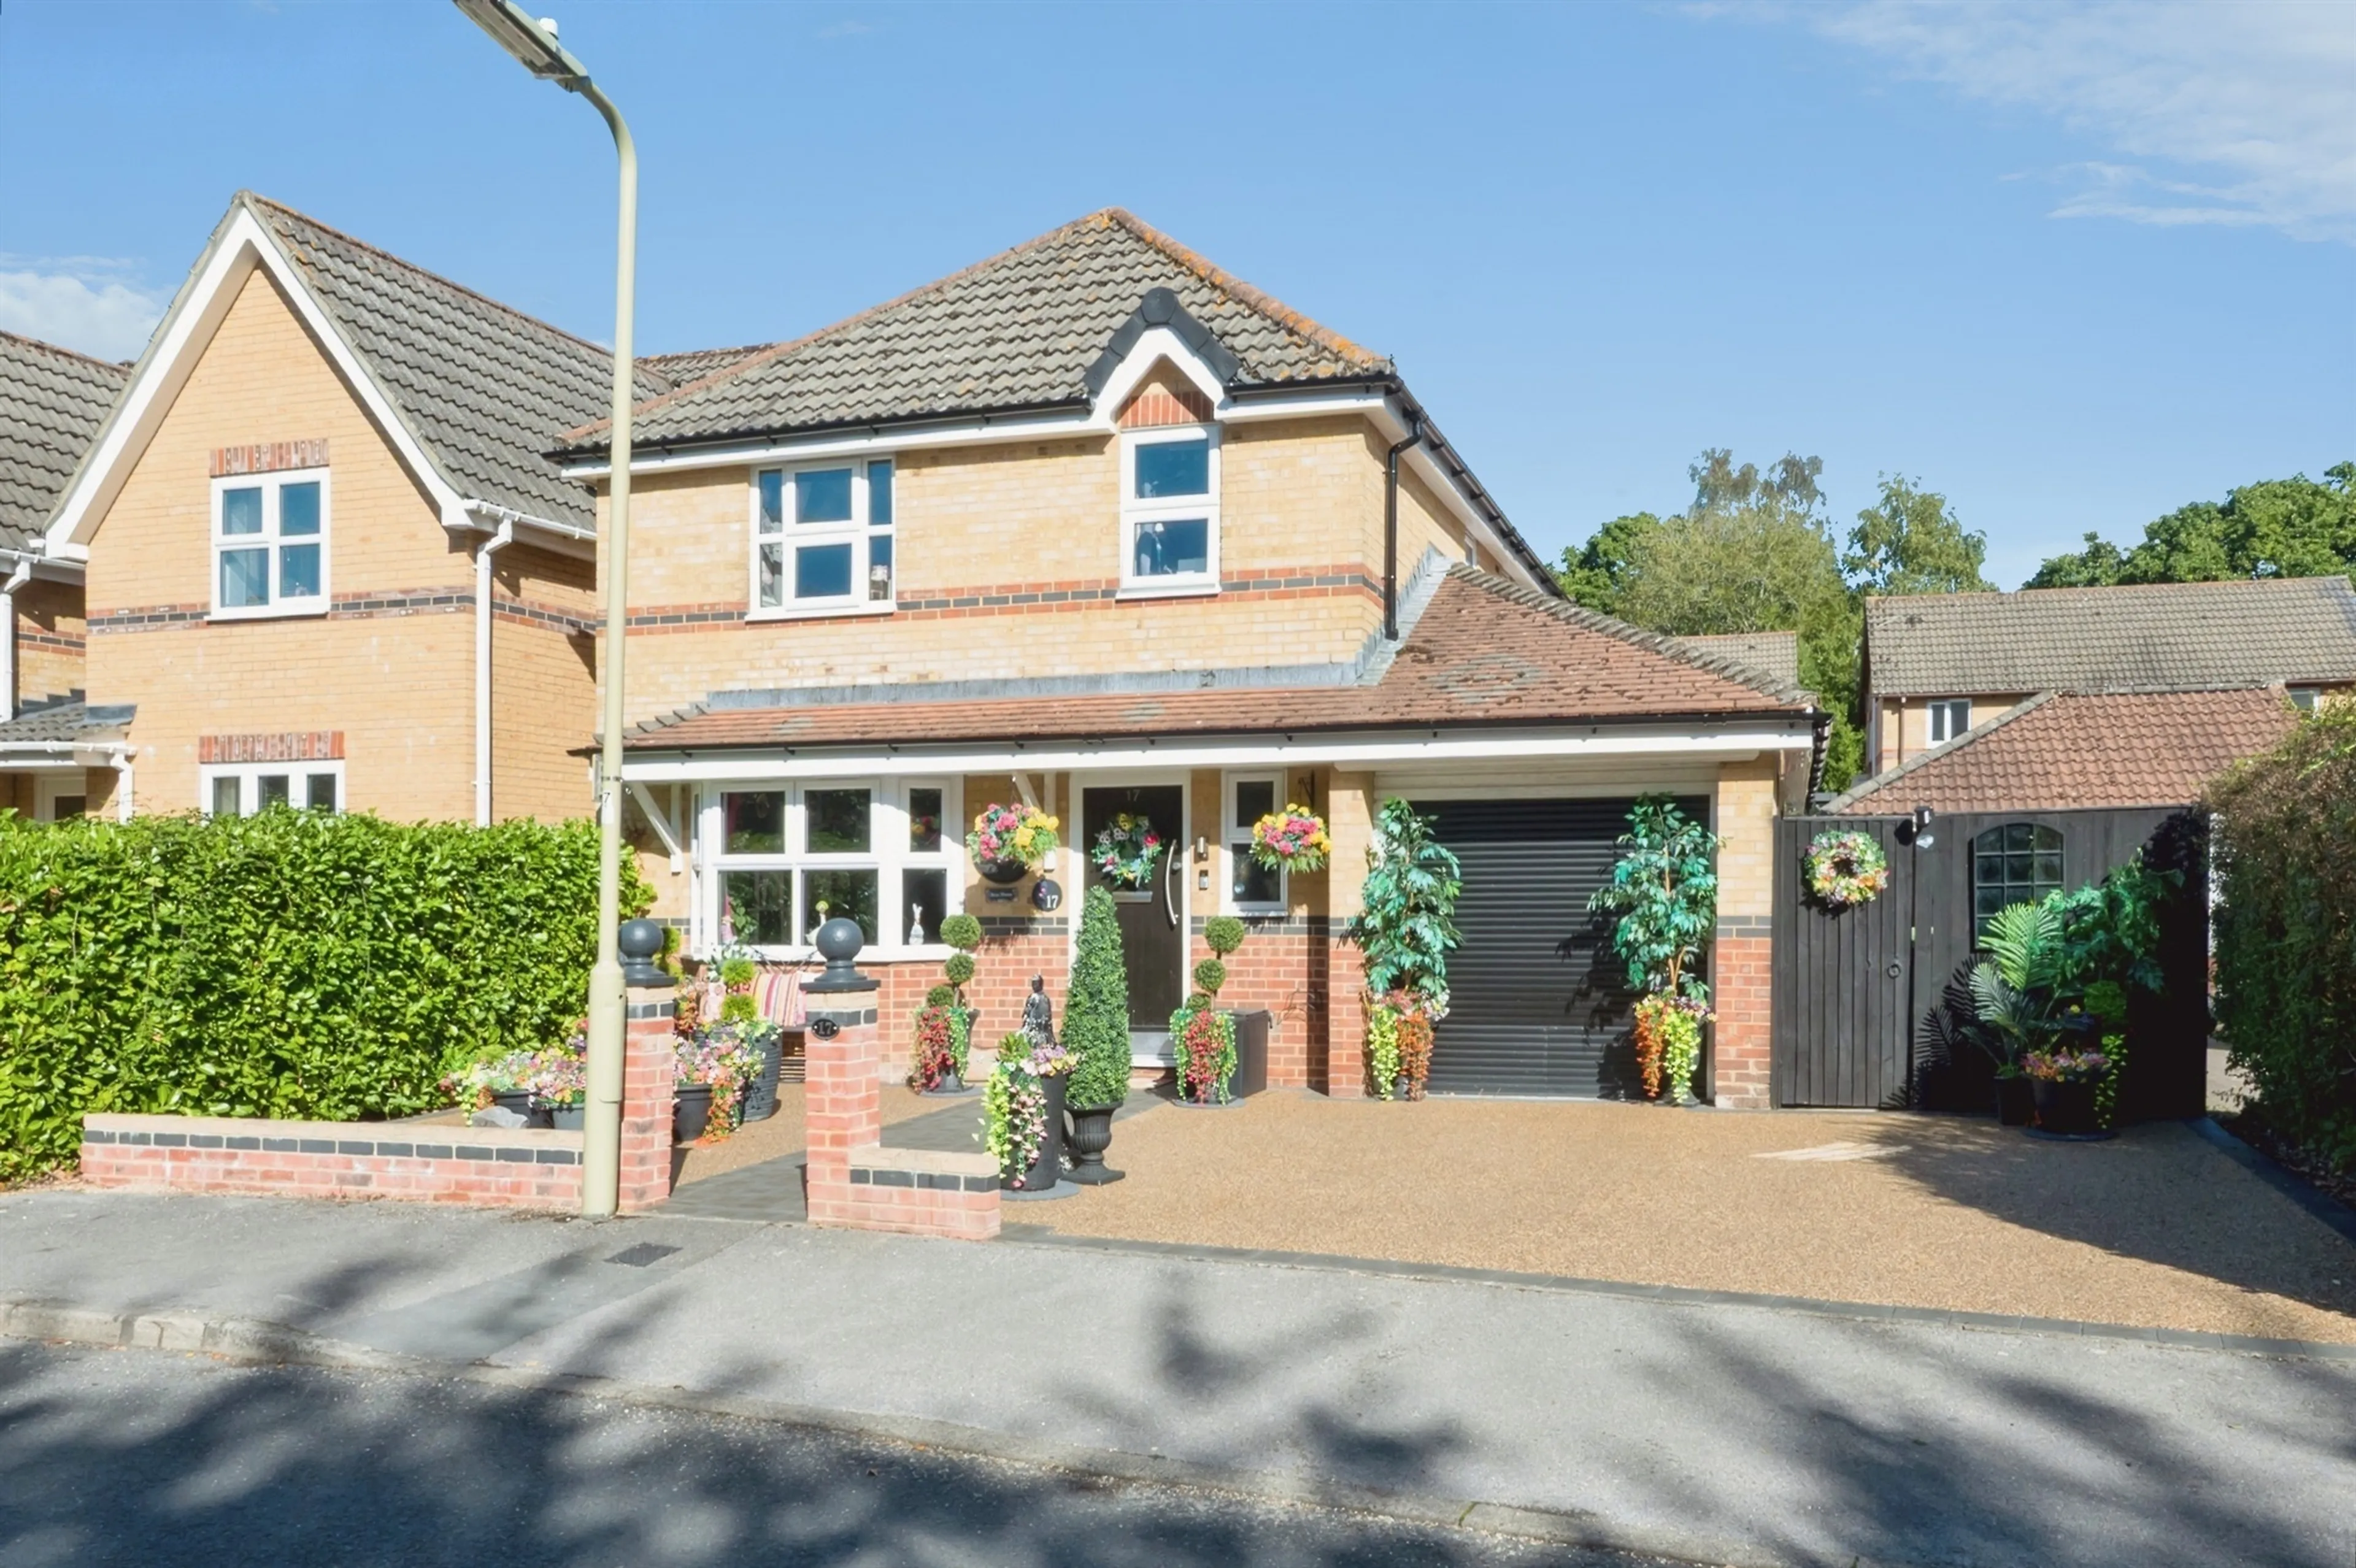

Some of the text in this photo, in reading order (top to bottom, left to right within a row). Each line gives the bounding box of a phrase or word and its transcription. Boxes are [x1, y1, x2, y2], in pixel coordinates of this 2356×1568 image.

[1126, 790, 1140, 802] 17
[1047, 895, 1058, 909] 17
[818, 1021, 832, 1035] 17
